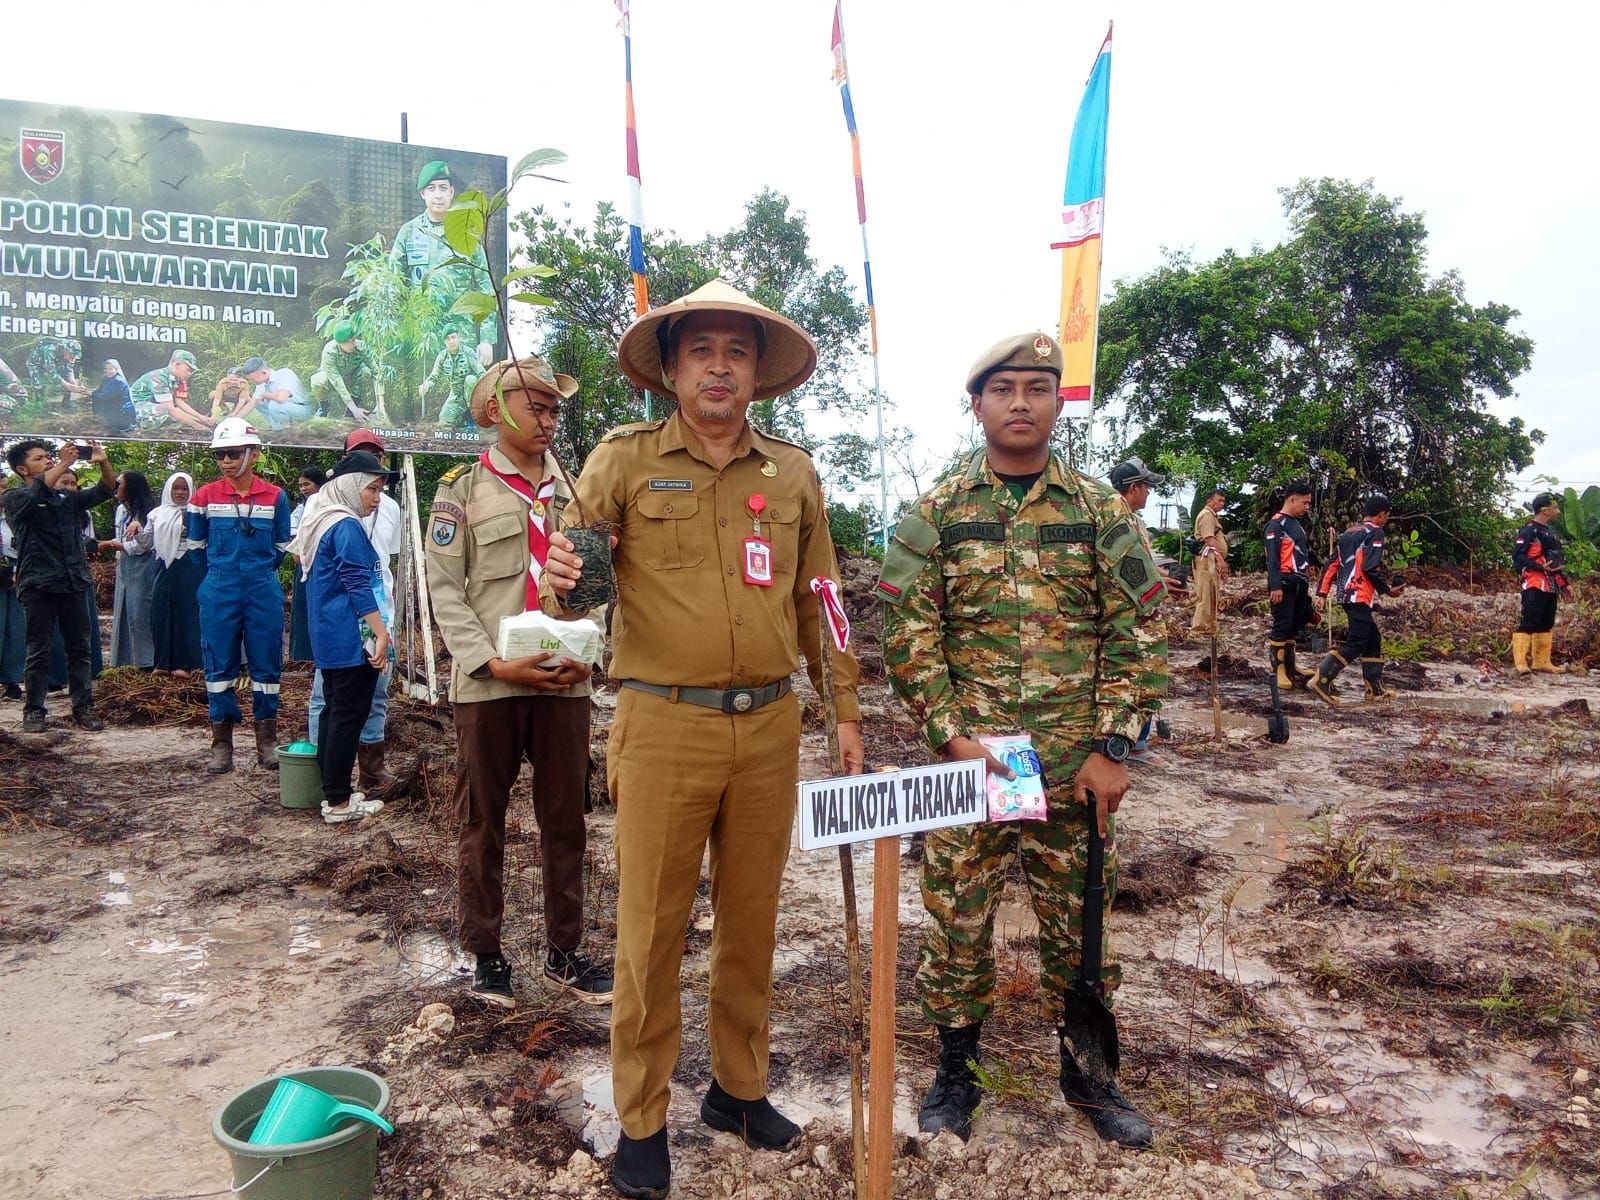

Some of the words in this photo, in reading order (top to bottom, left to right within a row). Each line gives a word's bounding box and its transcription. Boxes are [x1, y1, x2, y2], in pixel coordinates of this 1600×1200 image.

[0, 197, 132, 241] POHON
[141, 210, 329, 258] SERENTAK
[0, 239, 298, 297] MULAWARMAN
[25, 291, 124, 314] Menyatu
[131, 297, 215, 321] dengan
[222, 305, 282, 328] Alam,
[0, 315, 77, 338] Energi
[83, 320, 187, 344] Kebaikan
[1047, 525, 1094, 540] KOMCA
[540, 639, 561, 650] Livi
[811, 780, 899, 838] WALIKOTA
[902, 768, 977, 823] TARAKAN
